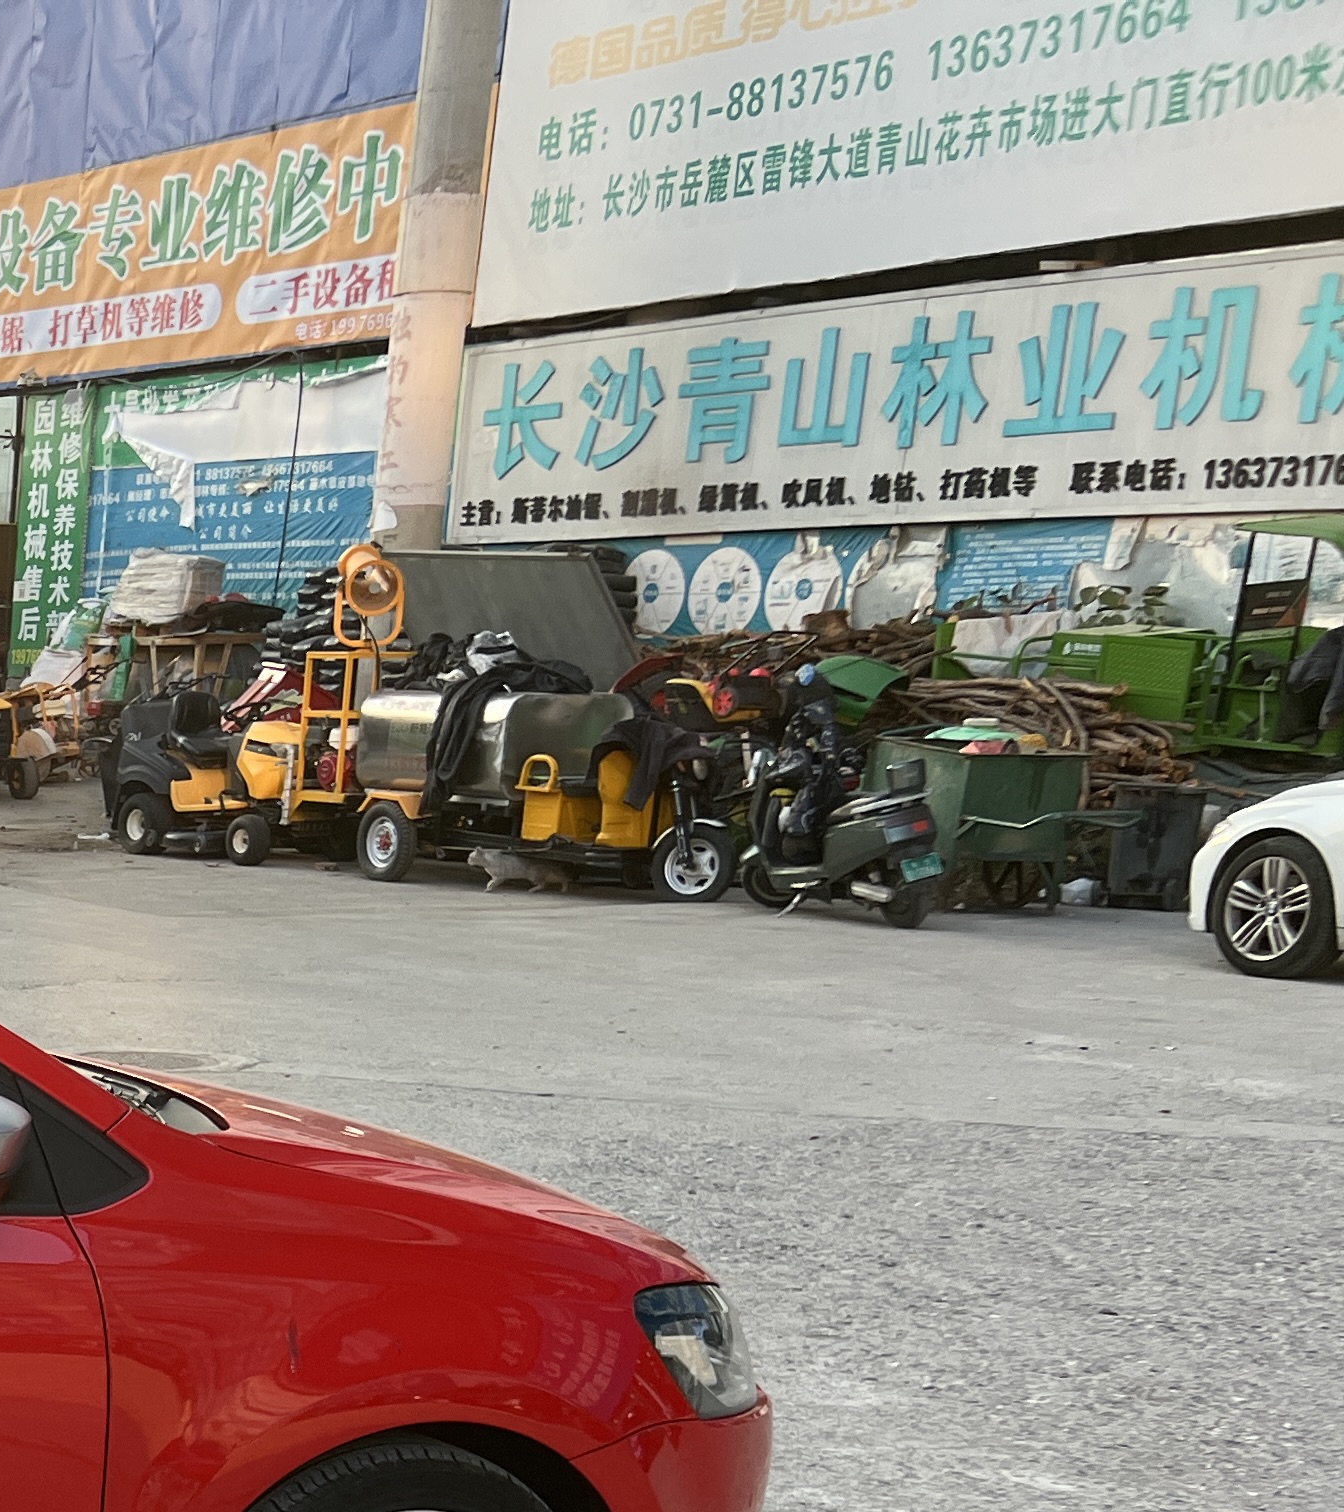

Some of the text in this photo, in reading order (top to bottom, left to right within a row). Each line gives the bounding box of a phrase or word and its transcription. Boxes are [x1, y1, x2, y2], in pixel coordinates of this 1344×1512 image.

[928, 0, 1191, 81] 13637317664
[528, 43, 1344, 233] 地址：长沙市岳麓区雷锋大道青山花卉市场进大门直行100米
